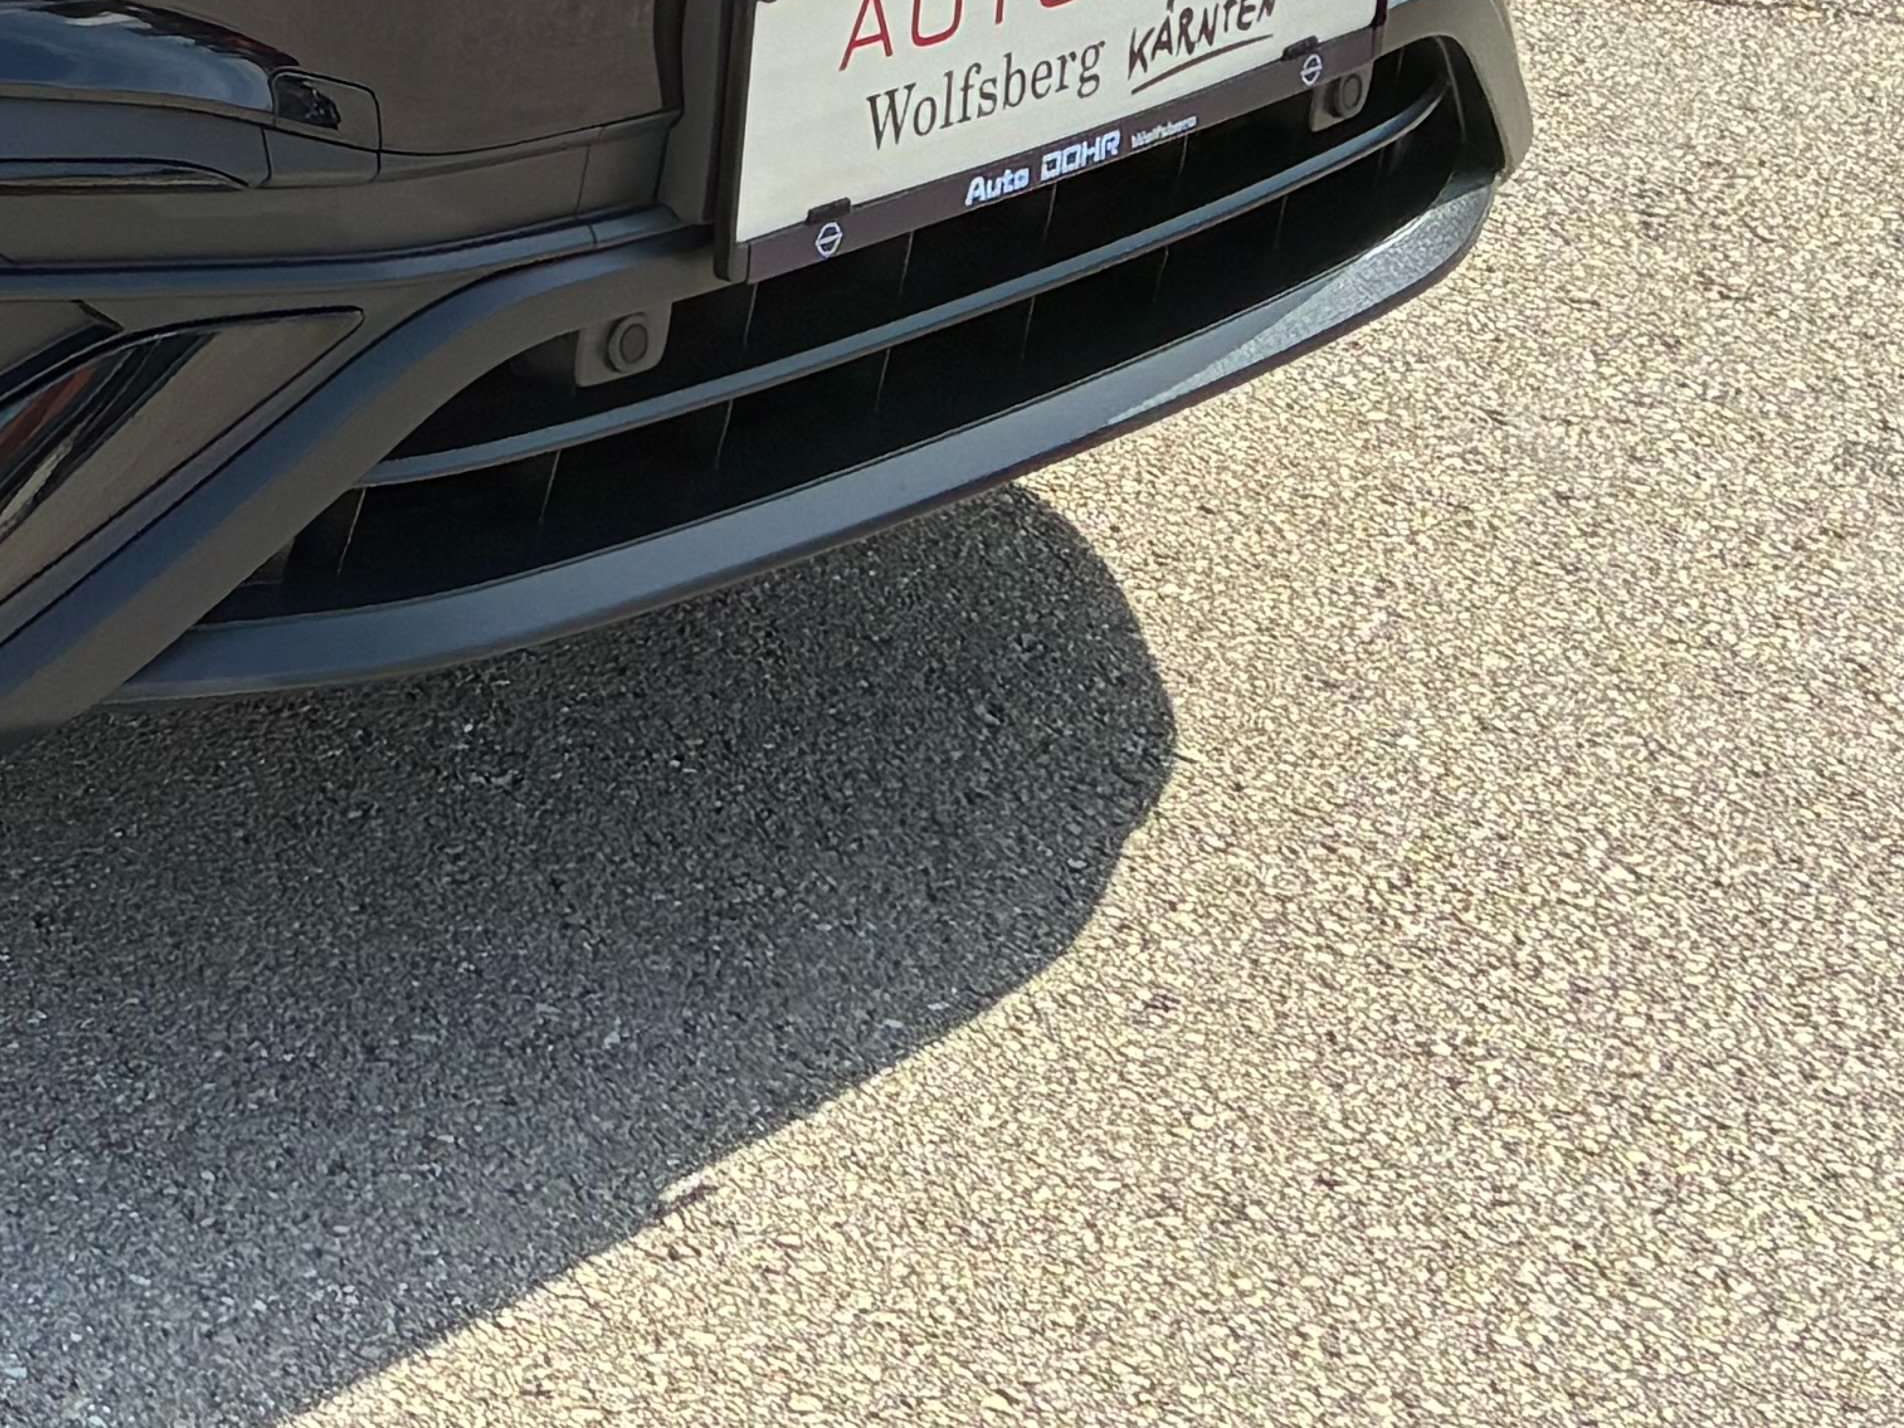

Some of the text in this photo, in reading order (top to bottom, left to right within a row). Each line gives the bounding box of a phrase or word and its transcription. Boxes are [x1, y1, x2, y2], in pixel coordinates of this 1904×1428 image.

[865, 40, 1106, 152] Wolfsberg
[964, 166, 1031, 207] Auto
[1040, 128, 1122, 182] DOHR
